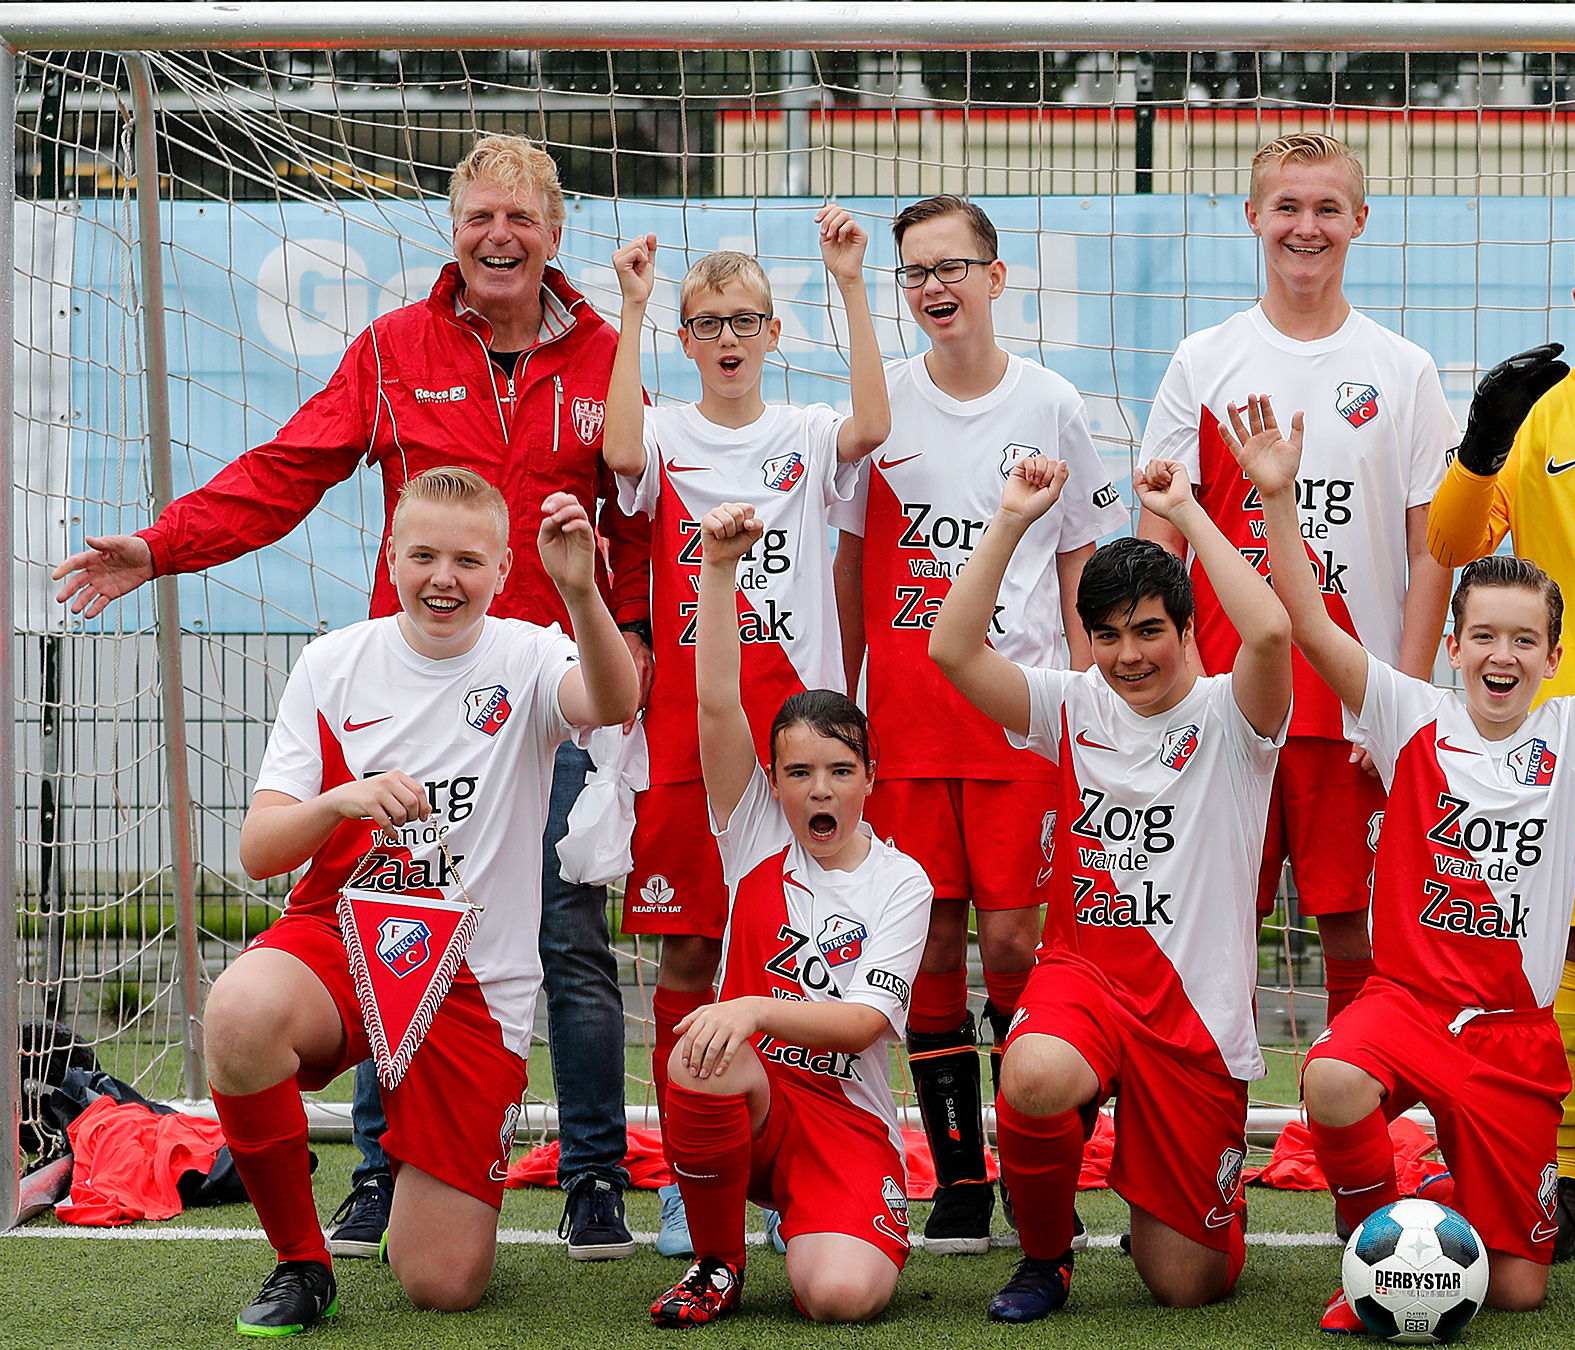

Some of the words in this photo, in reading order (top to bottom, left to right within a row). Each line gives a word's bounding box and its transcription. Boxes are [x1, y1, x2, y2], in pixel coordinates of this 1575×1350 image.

[415, 388, 449, 399] Reece
[1341, 388, 1376, 418] UTRECHT
[1359, 407, 1370, 420] C
[772, 454, 799, 489] UTRECHT
[789, 471, 798, 482] C
[900, 504, 990, 551] Zor
[740, 568, 768, 590] de
[910, 560, 952, 578] van
[680, 599, 795, 643] Zak
[474, 694, 483, 707] F
[474, 688, 505, 729] UTRECHT
[492, 710, 504, 723] C
[1166, 727, 1197, 766] UTRECHT
[1181, 746, 1190, 758] C
[1526, 740, 1545, 784] UTRECHT
[1541, 761, 1553, 773] C
[1428, 793, 1547, 866] Zorg
[350, 845, 464, 890] Zaak
[1080, 848, 1116, 871] van
[1119, 847, 1148, 871] de
[1436, 855, 1483, 879] van
[1488, 858, 1518, 882] de
[1072, 875, 1174, 926] Zaak
[1420, 880, 1530, 938] Zaak
[391, 925, 400, 938] F
[833, 921, 843, 932] F
[384, 926, 427, 964] UTRECHT
[820, 927, 865, 953] UTRECHT
[405, 950, 418, 965] C
[840, 947, 852, 960] C
[1375, 1270, 1461, 1290] DERBYSTAR
